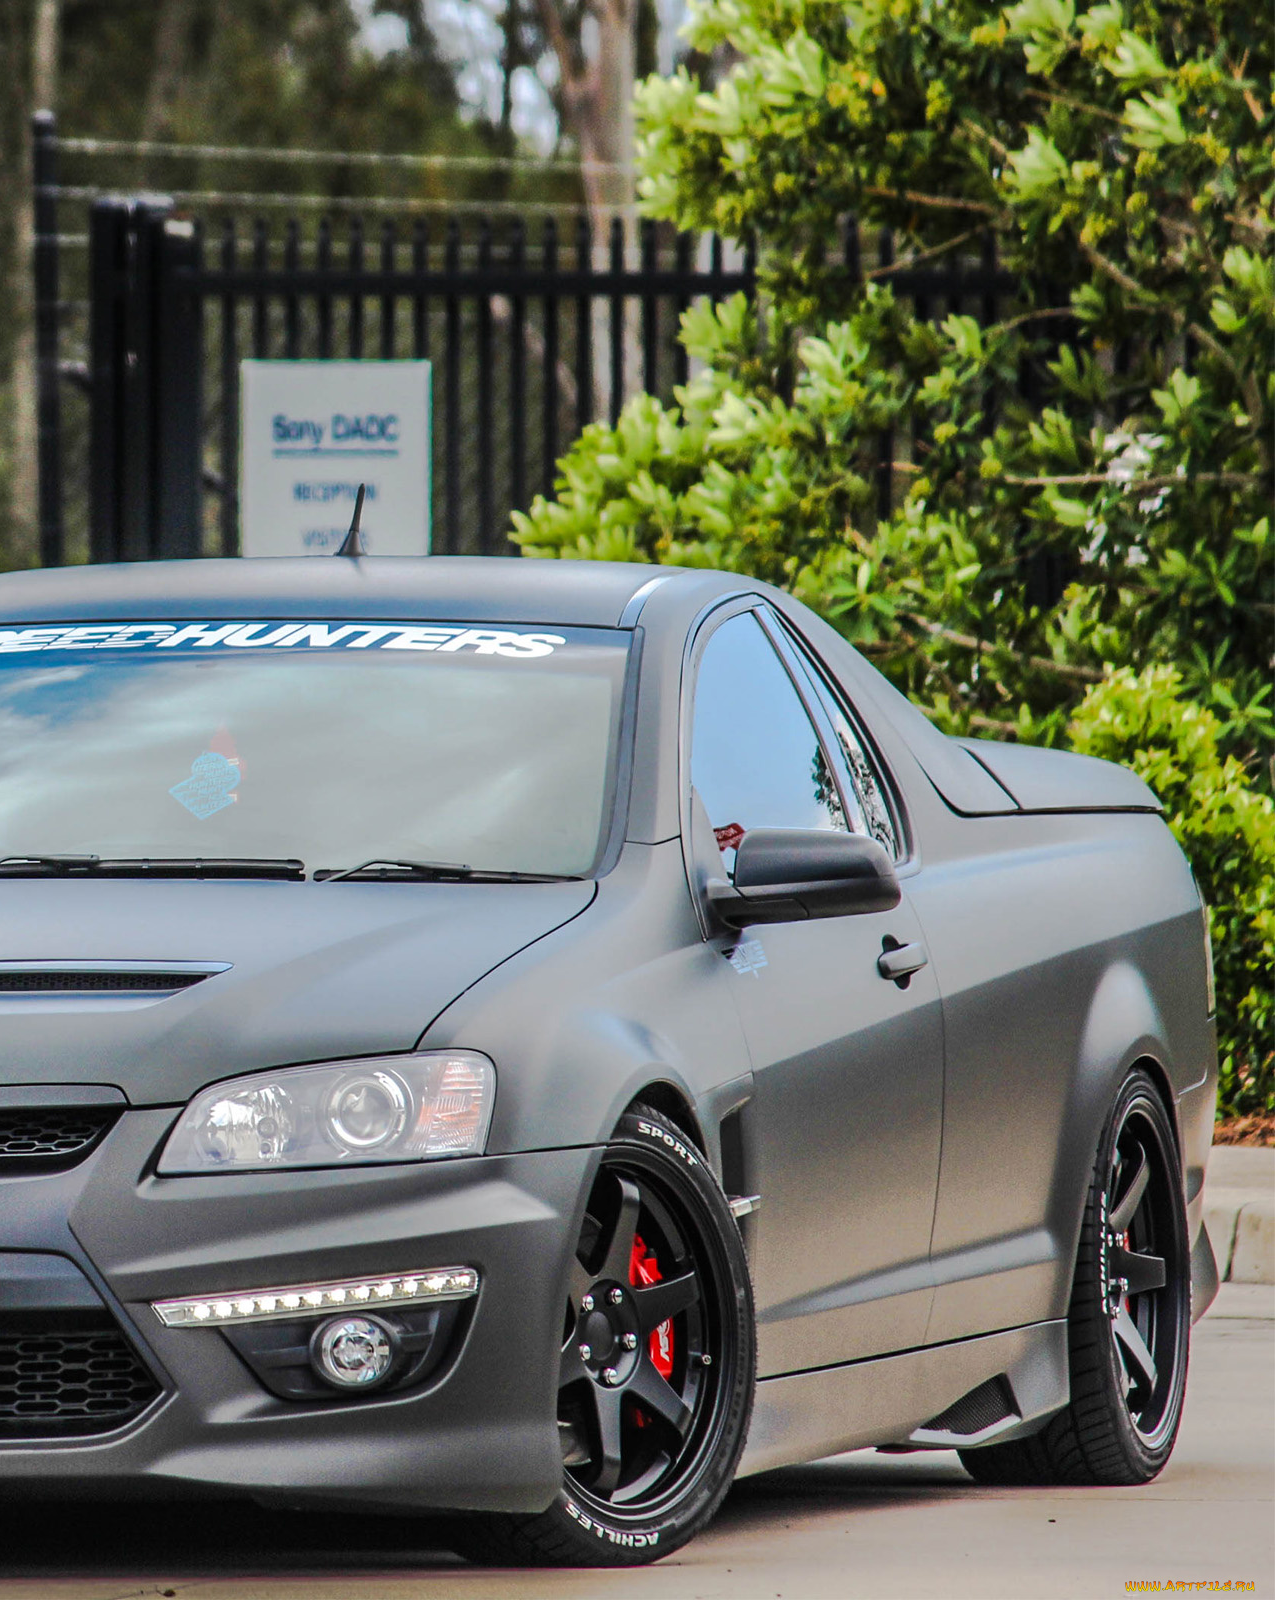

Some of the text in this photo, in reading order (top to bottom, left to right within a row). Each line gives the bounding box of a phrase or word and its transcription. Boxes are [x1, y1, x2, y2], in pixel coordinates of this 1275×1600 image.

[272, 414, 398, 444] Sony DADC
[638, 1121, 698, 1166] SPORT
[565, 1502, 660, 1548] ACHILLES
